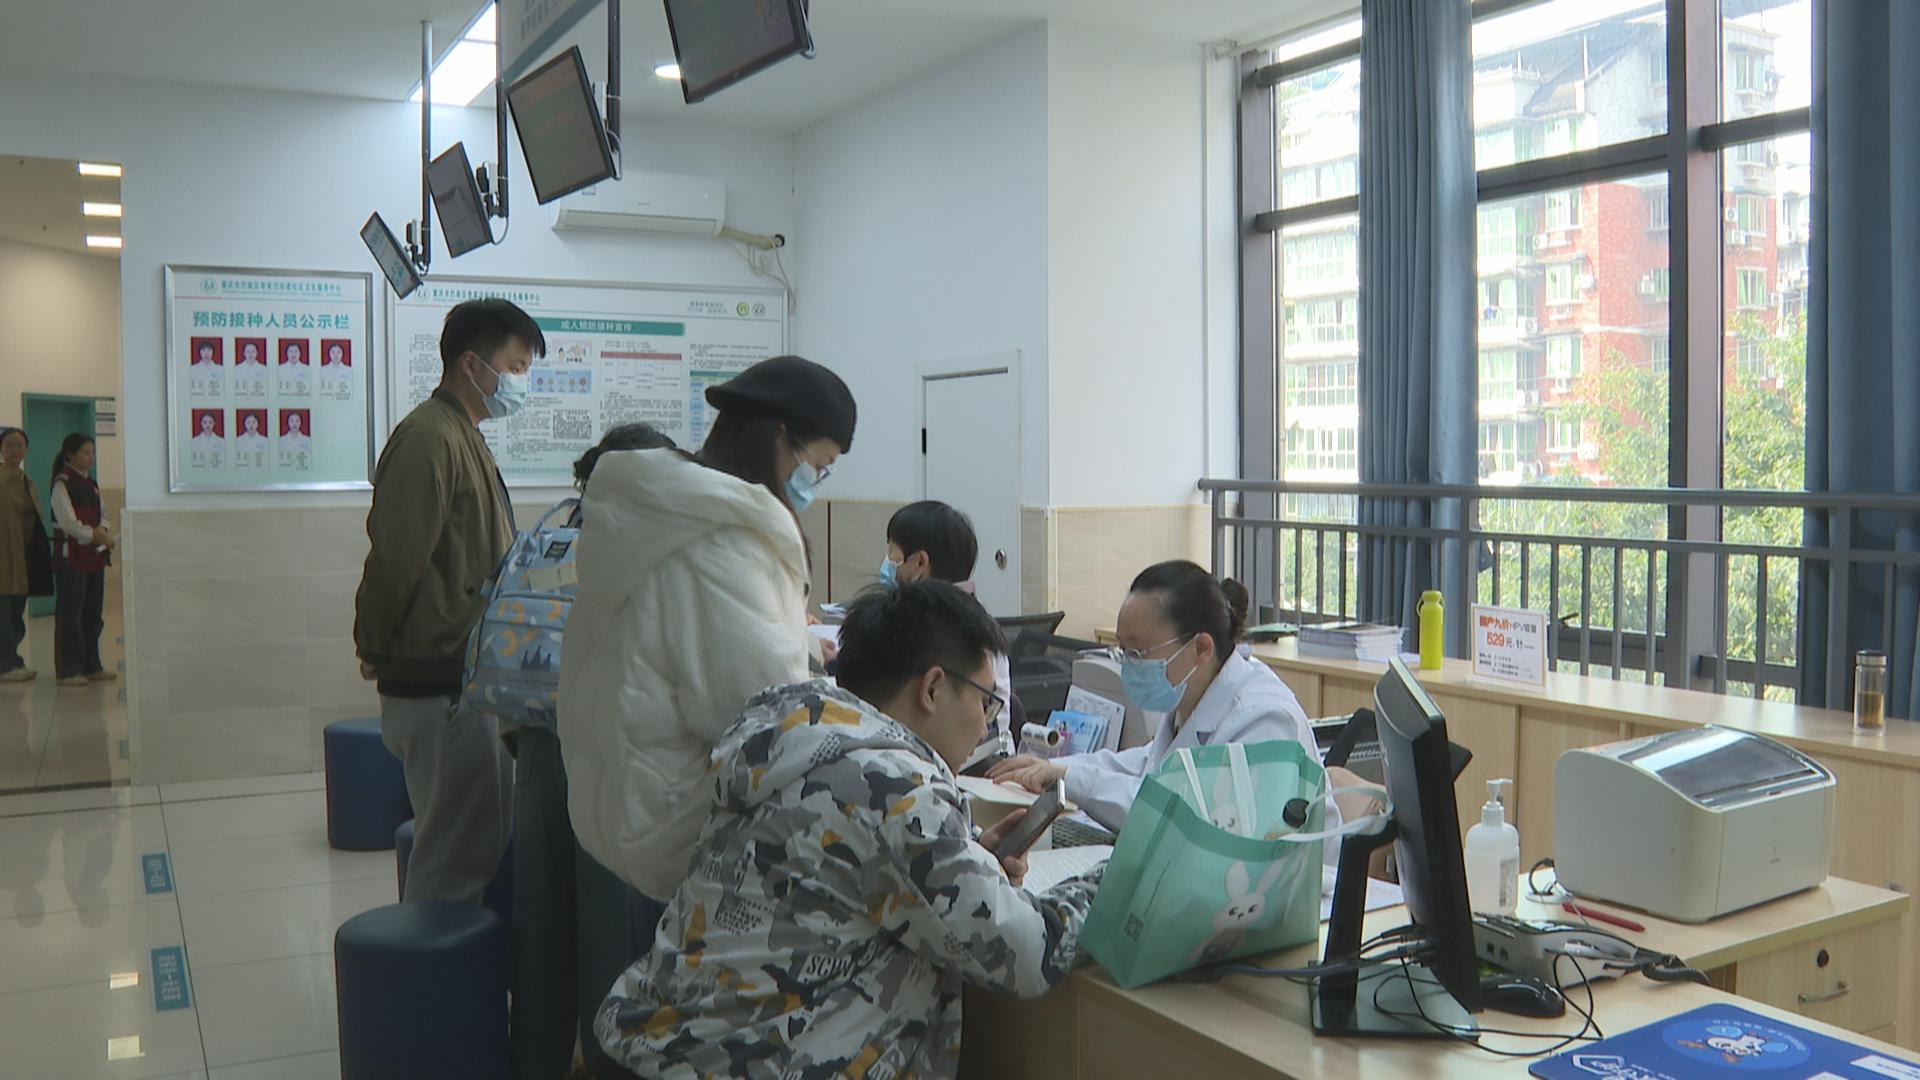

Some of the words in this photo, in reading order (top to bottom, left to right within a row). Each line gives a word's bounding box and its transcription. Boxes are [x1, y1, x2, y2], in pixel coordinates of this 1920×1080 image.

[193, 311, 350, 329] 预防接种人员公示栏
[561, 321, 632, 333] 成人预防接种宣传
